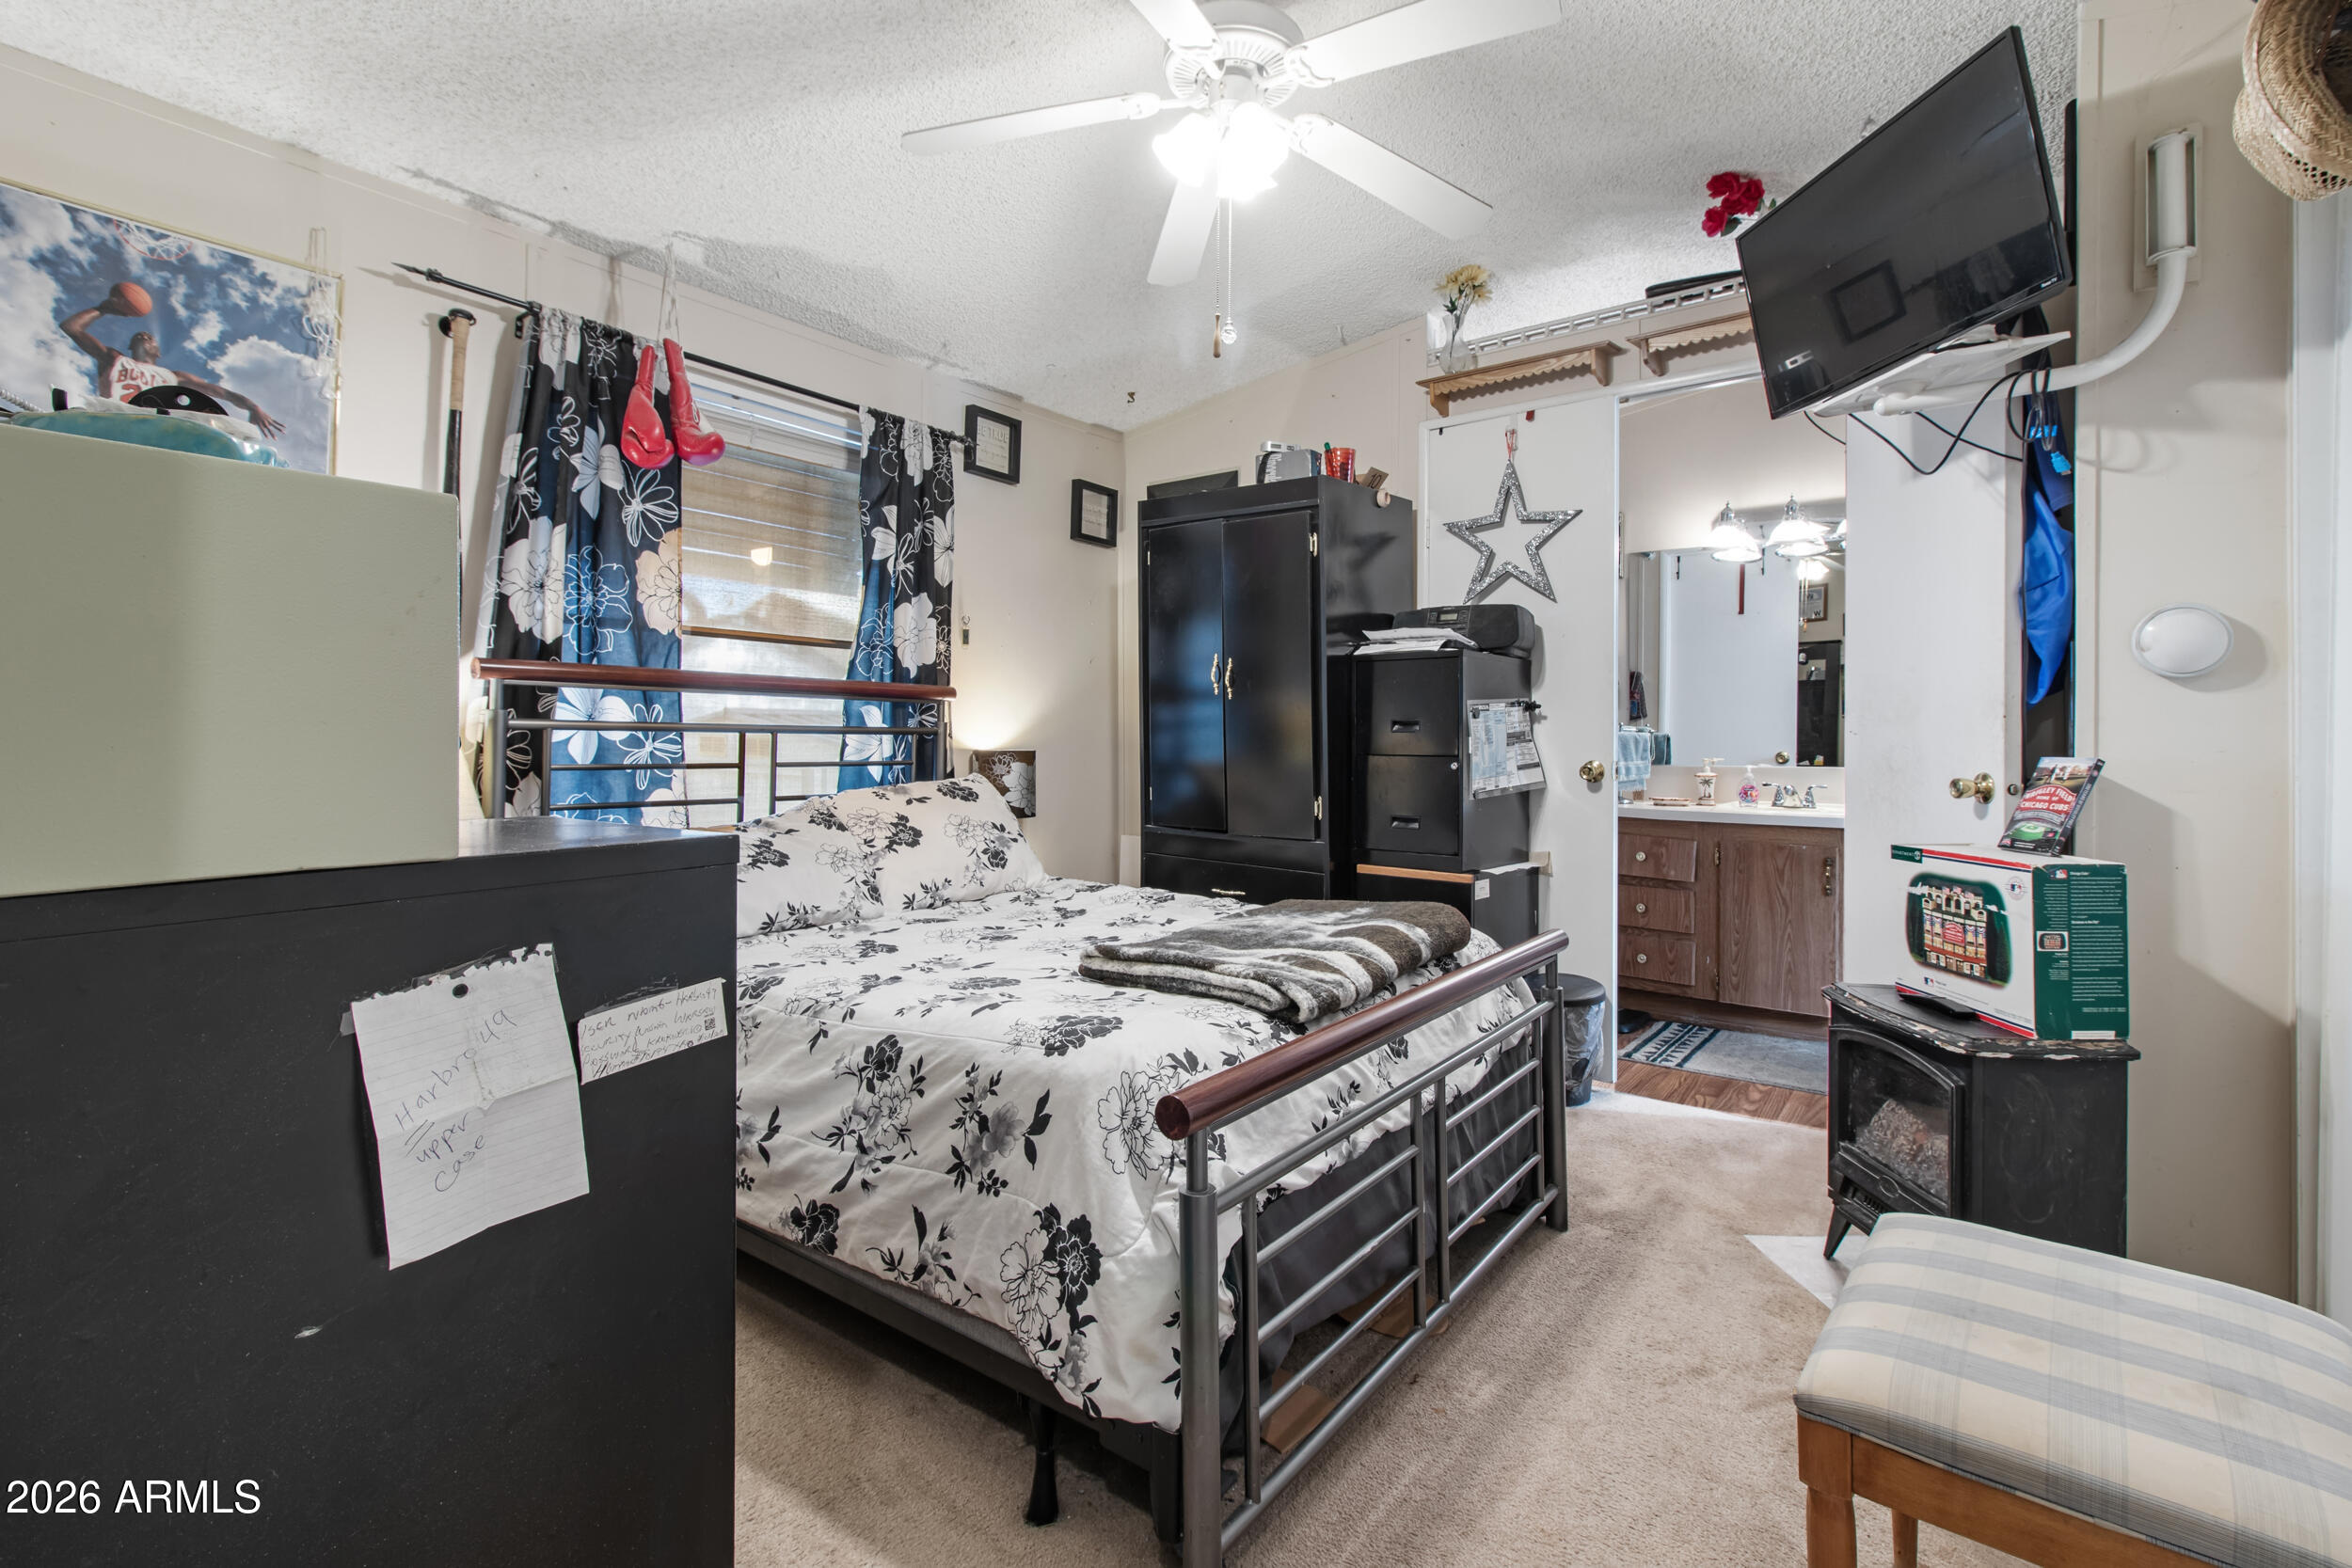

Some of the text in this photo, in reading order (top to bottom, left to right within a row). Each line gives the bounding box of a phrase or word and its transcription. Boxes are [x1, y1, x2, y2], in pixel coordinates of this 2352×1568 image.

[2056, 788, 2073, 802] FIELD
[2021, 800, 2069, 811] CHICAGO CUBS
